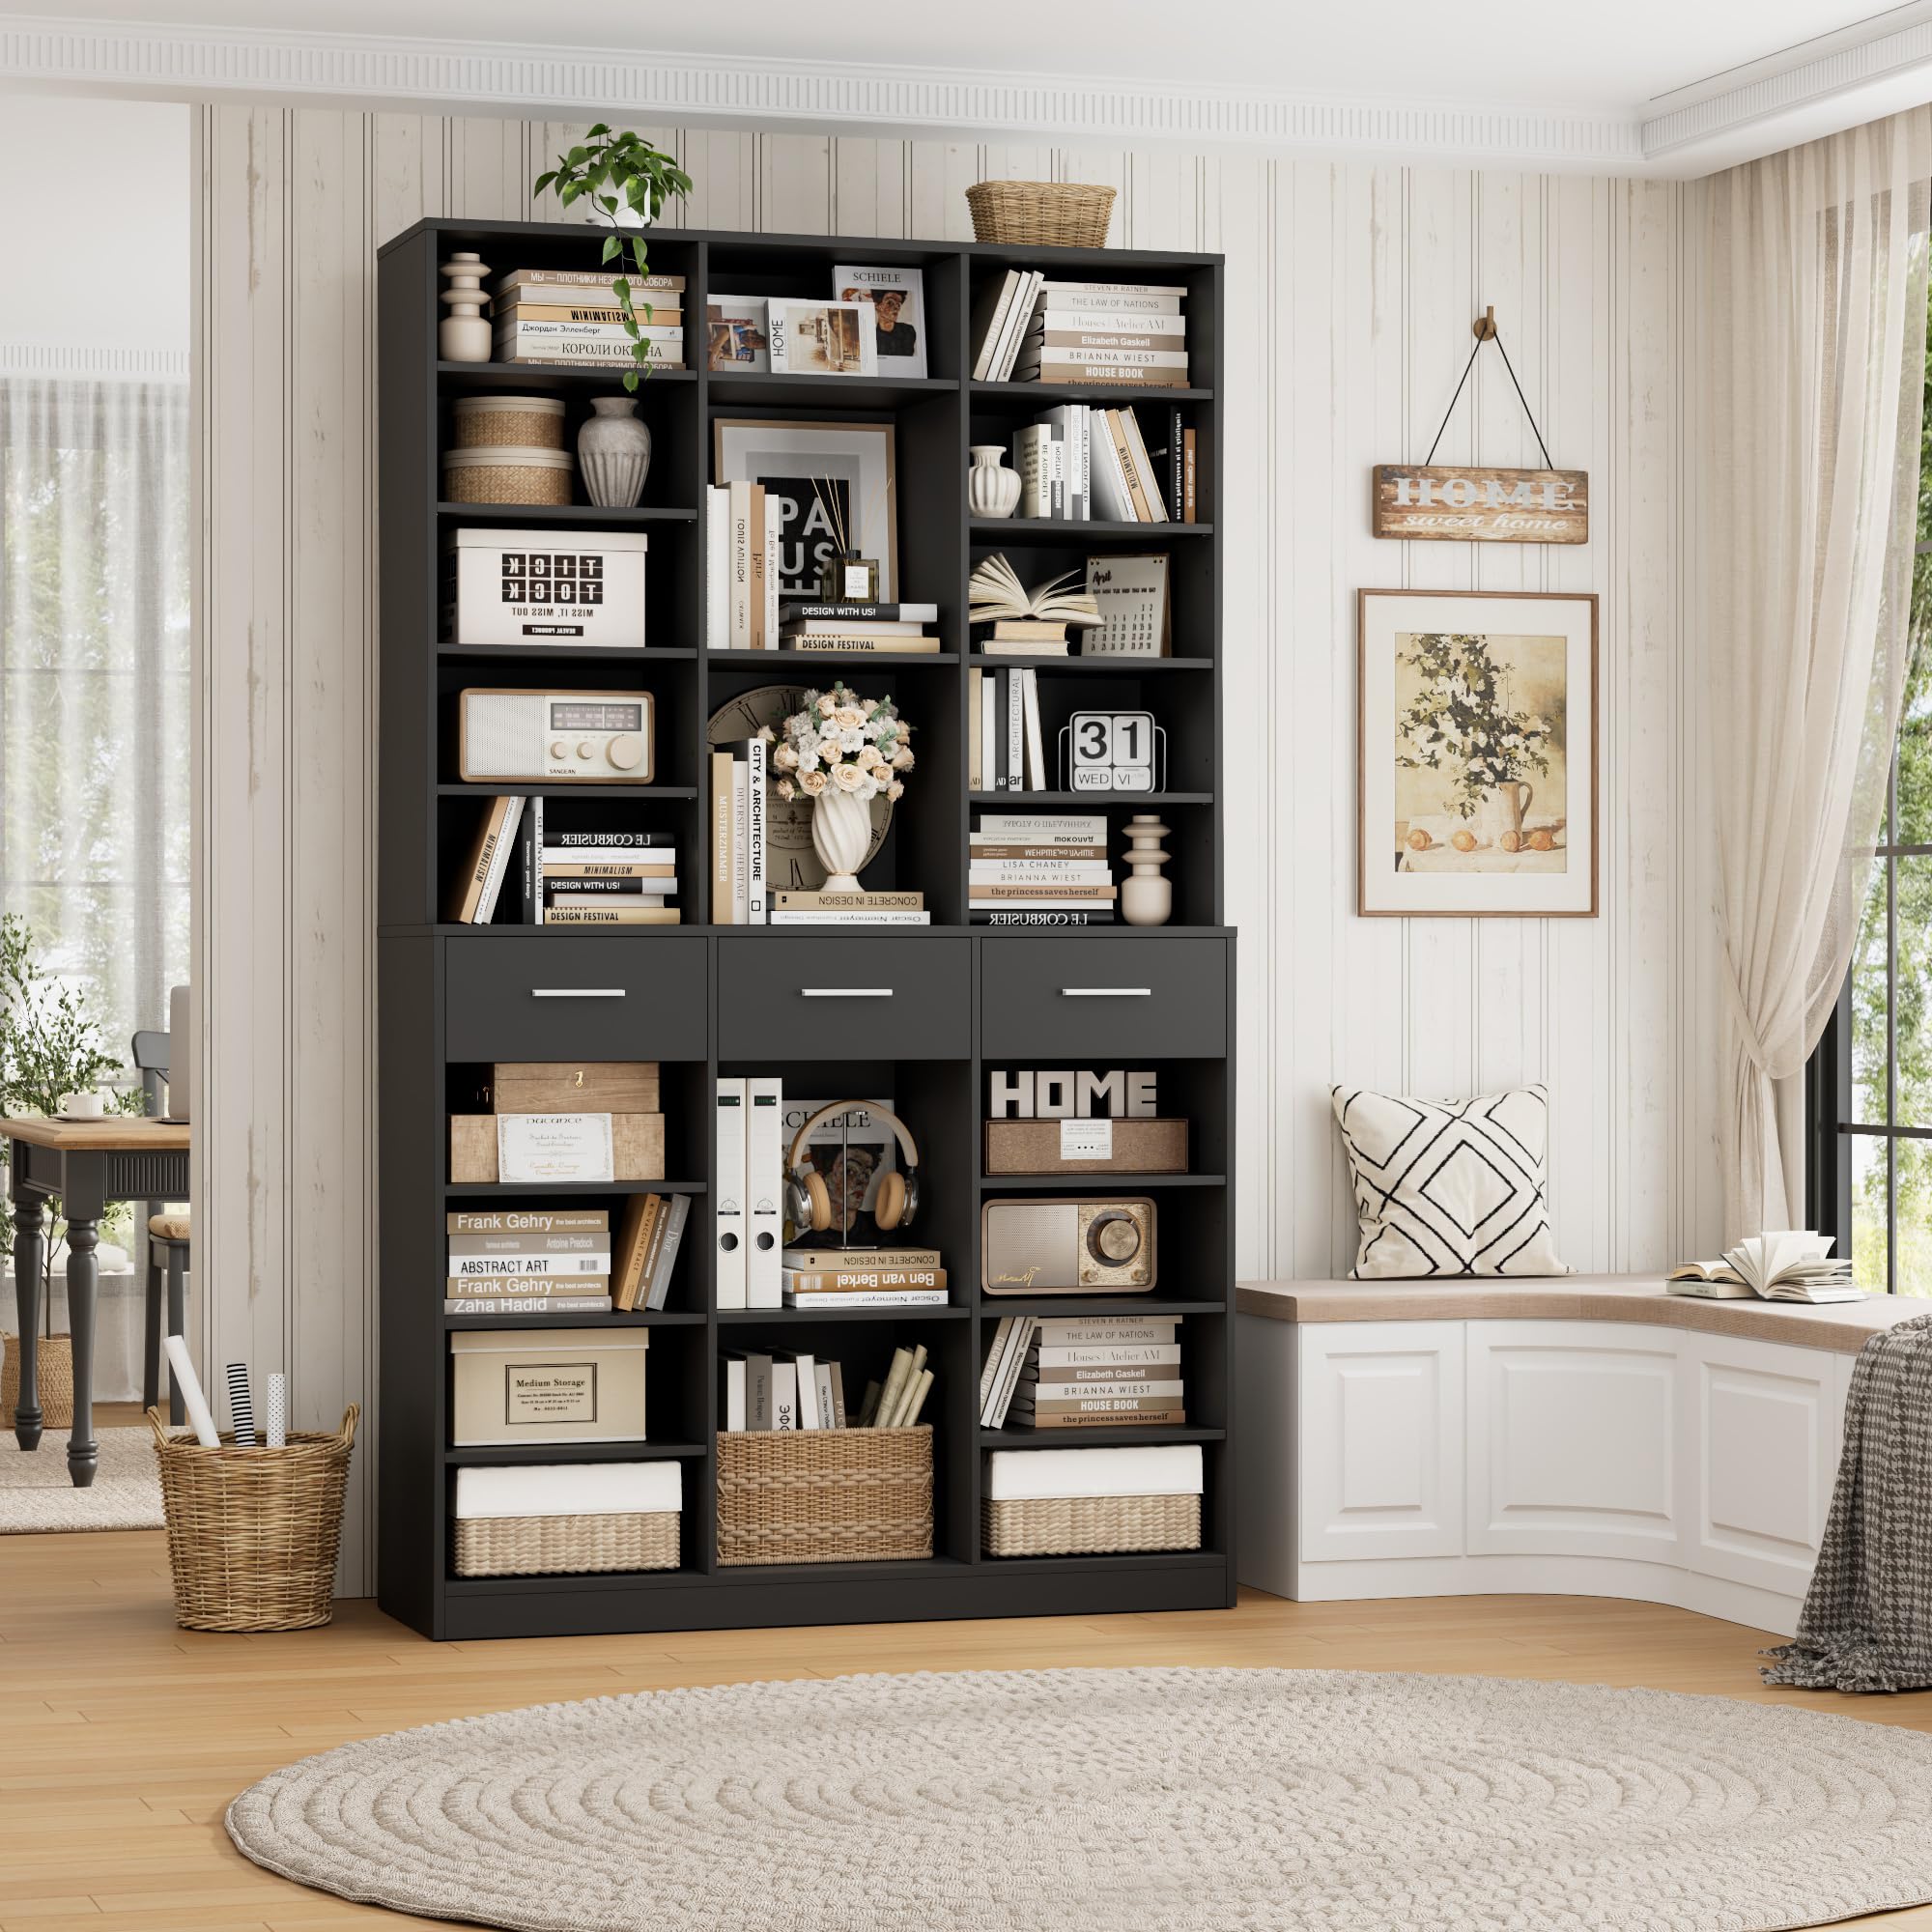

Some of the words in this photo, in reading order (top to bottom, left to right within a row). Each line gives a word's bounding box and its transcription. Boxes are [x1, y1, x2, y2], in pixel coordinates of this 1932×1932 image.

[531, 272, 545, 282] МЫ
[556, 272, 597, 284] ПЛОТНИКИ
[853, 272, 900, 282] SCHIELE
[1092, 298, 1107, 306] LAW
[1072, 317, 1105, 327] Houses
[1115, 318, 1143, 329] Atelier
[522, 324, 557, 333] Джордан
[560, 326, 601, 336] Элленберг
[772, 319, 784, 356] HOME
[1082, 336, 1118, 346] Elizabeth
[1121, 338, 1150, 347] Gaskell
[562, 343, 611, 355] КОРОЛИ
[614, 346, 663, 357] ОКНА
[1069, 352, 1118, 361] BRIANNA
[1124, 354, 1155, 362] WIEST
[1086, 367, 1116, 377] HOUSE
[1119, 368, 1144, 379] BOOK
[1391, 477, 1576, 510] HOME
[779, 497, 836, 537] PA
[1404, 515, 1484, 527] sweet
[1492, 512, 1569, 530] home
[1093, 570, 1112, 585] April
[802, 607, 834, 615] DESIGN
[862, 608, 875, 616] US!
[802, 639, 834, 649] DESIGN
[838, 639, 875, 650] FESTIVAL
[753, 745, 761, 773] CITY
[1079, 774, 1109, 784] WED
[1119, 773, 1130, 784] VI
[719, 796, 727, 882] MUSTERZIMMER
[753, 788, 761, 881] ARCHITECTURE
[475, 834, 497, 882] MINIMALISM
[584, 866, 633, 874] MINIMALISM
[819, 896, 854, 905] DESIGN
[856, 896, 866, 905] IN
[867, 896, 917, 905] CONCRETE
[551, 912, 581, 921] DESIGN
[584, 912, 618, 921] FESTIVAL
[991, 1070, 1157, 1118] HOME
[458, 1214, 500, 1229] Frank
[506, 1214, 553, 1231] Gehry
[665, 1230, 678, 1253] Dior
[461, 1260, 522, 1273] ABSTRACT
[526, 1260, 549, 1273] ART
[844, 1257, 876, 1265] DESIGN
[838, 1273, 877, 1288] Berkel
[882, 1275, 905, 1286] van
[909, 1273, 934, 1286] Ben
[458, 1279, 500, 1293] Frank
[506, 1278, 553, 1295] Gehry
[454, 1299, 496, 1313] Zaha
[500, 1298, 547, 1312] Hadid
[1119, 1330, 1154, 1339] NATIONS
[1067, 1351, 1101, 1362] Houses
[1111, 1350, 1140, 1361] Atelier
[1076, 1370, 1113, 1379] Elizabeth
[1116, 1369, 1146, 1378] Gaskell
[554, 1378, 585, 1388] Storage
[1065, 1386, 1113, 1395] BRIANNA
[1119, 1385, 1151, 1394] WIEST
[1081, 1401, 1111, 1410] HOUSE
[1114, 1400, 1139, 1409] BOOK
